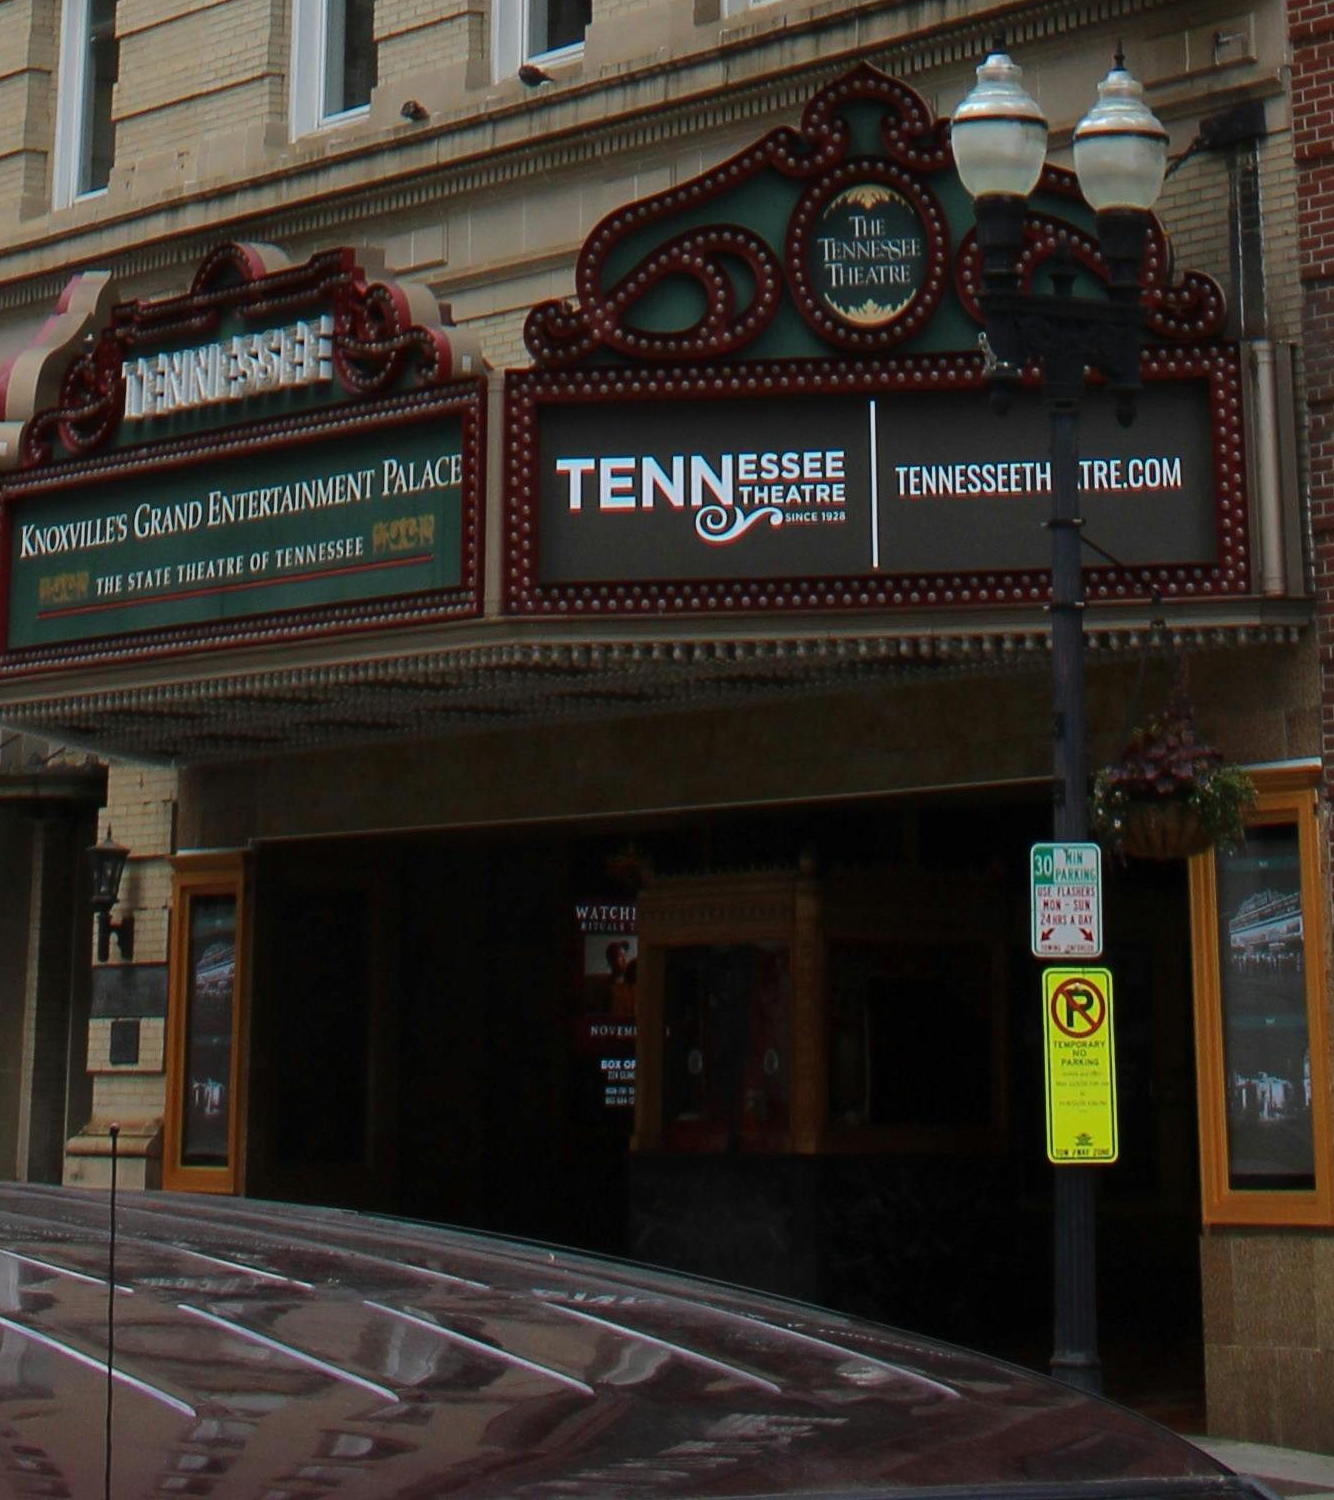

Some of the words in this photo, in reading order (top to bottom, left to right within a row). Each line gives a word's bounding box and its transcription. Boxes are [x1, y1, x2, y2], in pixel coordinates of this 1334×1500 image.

[849, 215, 885, 237] THE
[818, 236, 921, 264] TENNESSEE
[825, 262, 911, 288] THEATRE
[122, 314, 333, 420] TENNESSEE
[556, 450, 846, 511] TENNESSEE
[895, 457, 1182, 497] TENNESSEETHTRE.COM
[738, 484, 846, 506] THEATRE
[20, 510, 128, 558] KNOXVILLE'S
[134, 499, 203, 539] GRAND
[208, 469, 375, 528] ENTERTAINMENT
[381, 454, 462, 498] PALACE
[785, 511, 818, 523] SINCE
[821, 510, 847, 522] 1928
[96, 573, 123, 596] THE
[128, 566, 171, 590] STATE
[177, 557, 244, 584] THEATRE
[249, 552, 269, 573] OF
[275, 536, 364, 568] TENNESSEE
[1035, 855, 1052, 876] 30
[1065, 851, 1083, 864] MIN
[1056, 869, 1096, 882] PARKING
[1038, 886, 1051, 897] USE
[1058, 886, 1095, 897] FLASHERS
[1043, 900, 1061, 910] MON
[1074, 900, 1090, 911] SUN
[1070, 915, 1075, 925] A
[1078, 915, 1092, 926] DAY
[1053, 1040, 1105, 1049] TEMPORARY
[601, 1060, 622, 1069] BOX
[1061, 1058, 1099, 1066] PARKING
